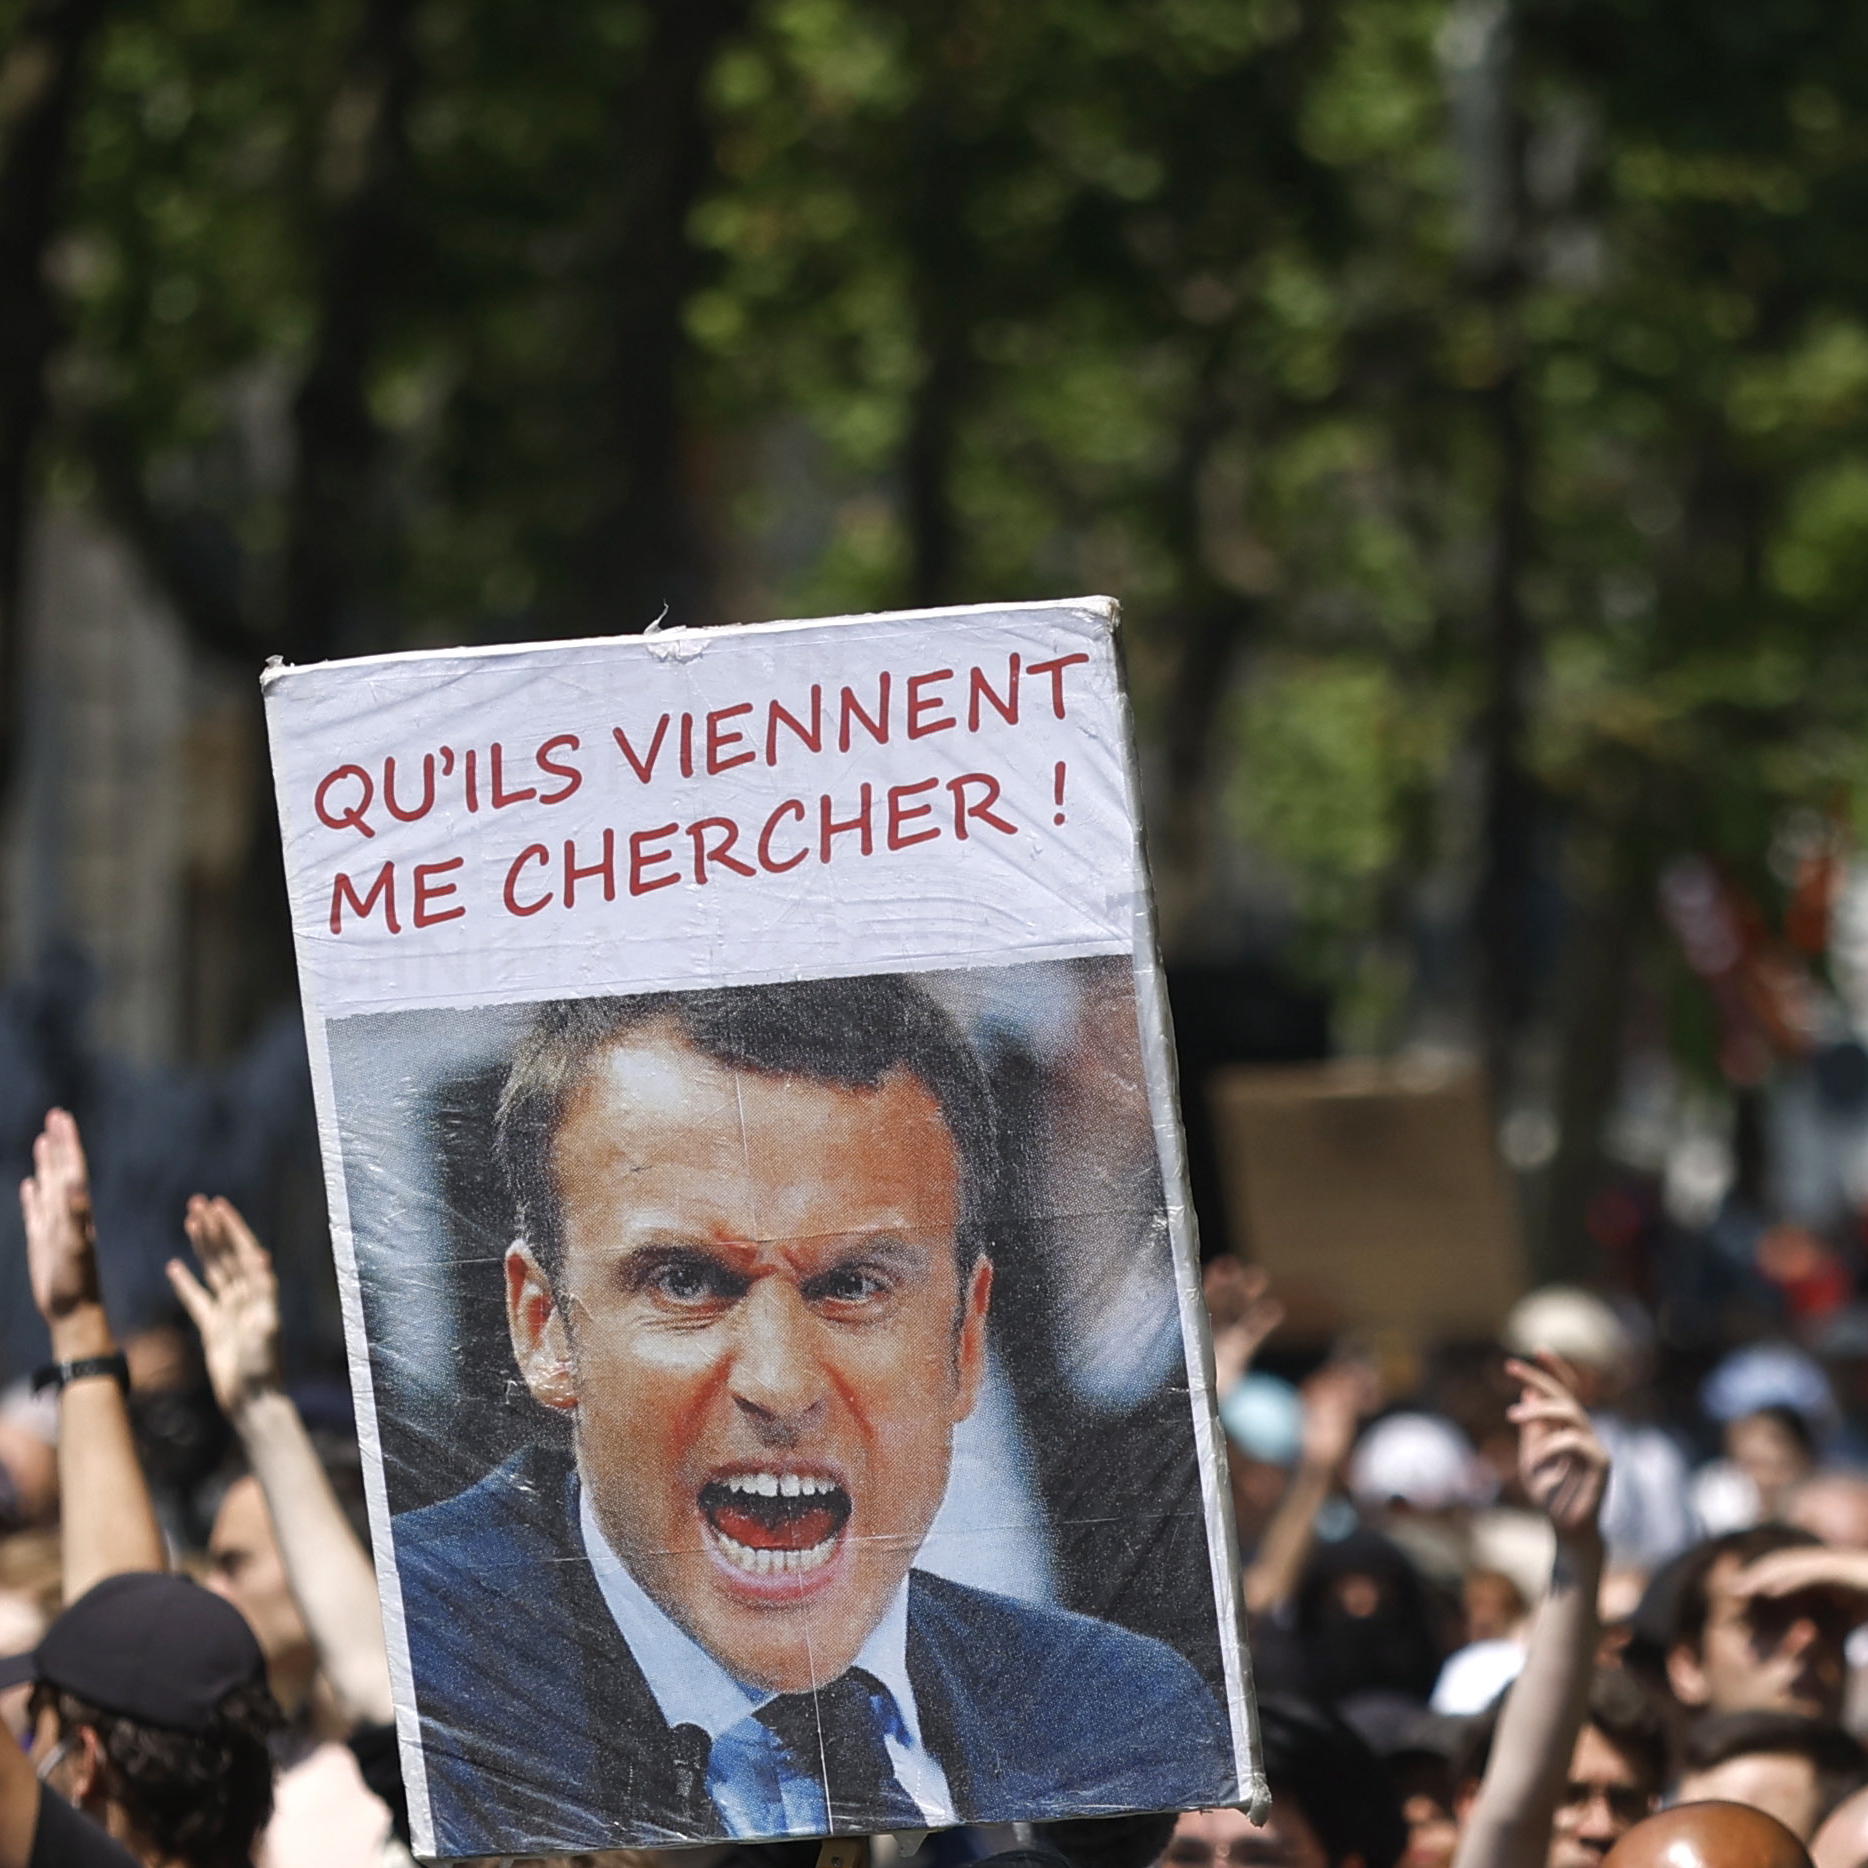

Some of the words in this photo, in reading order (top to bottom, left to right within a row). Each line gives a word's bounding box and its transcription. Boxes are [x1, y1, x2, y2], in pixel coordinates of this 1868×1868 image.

[315, 735, 582, 838] QU'ILS
[614, 653, 1089, 784] VIENNENT
[330, 857, 466, 934] ME
[504, 774, 1017, 916] CHERCHER
[1055, 760, 1067, 825] !
